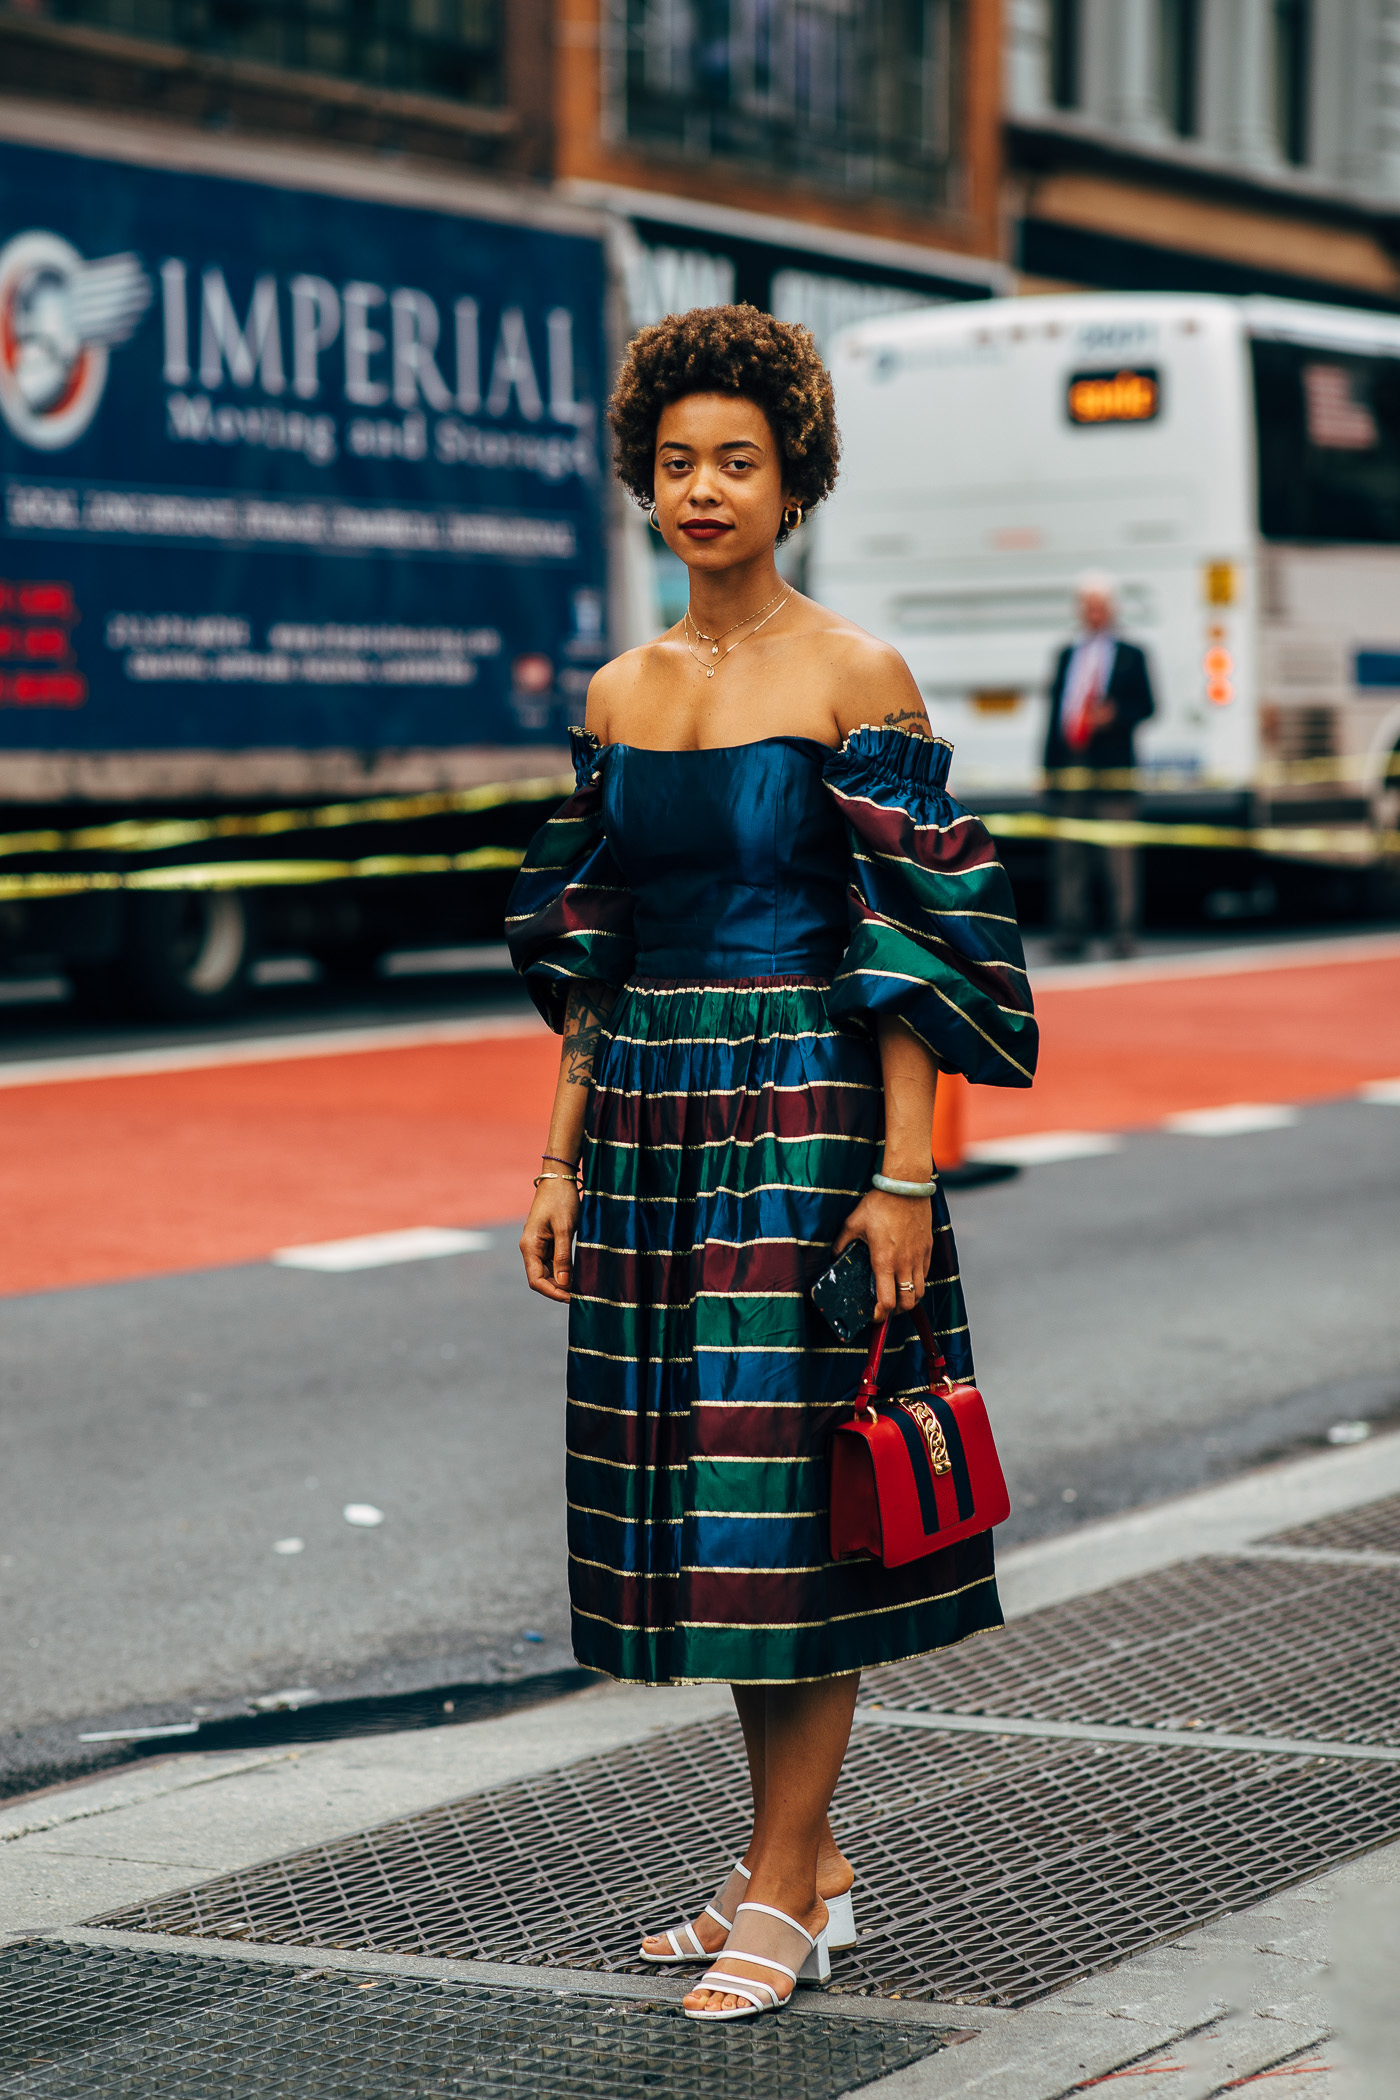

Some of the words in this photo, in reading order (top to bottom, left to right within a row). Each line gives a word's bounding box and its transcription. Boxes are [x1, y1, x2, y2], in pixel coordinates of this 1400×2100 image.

[159, 257, 597, 425] IMPERIAL
[167, 392, 337, 467] Moving
[347, 408, 428, 461] and
[434, 416, 597, 485] Storage
